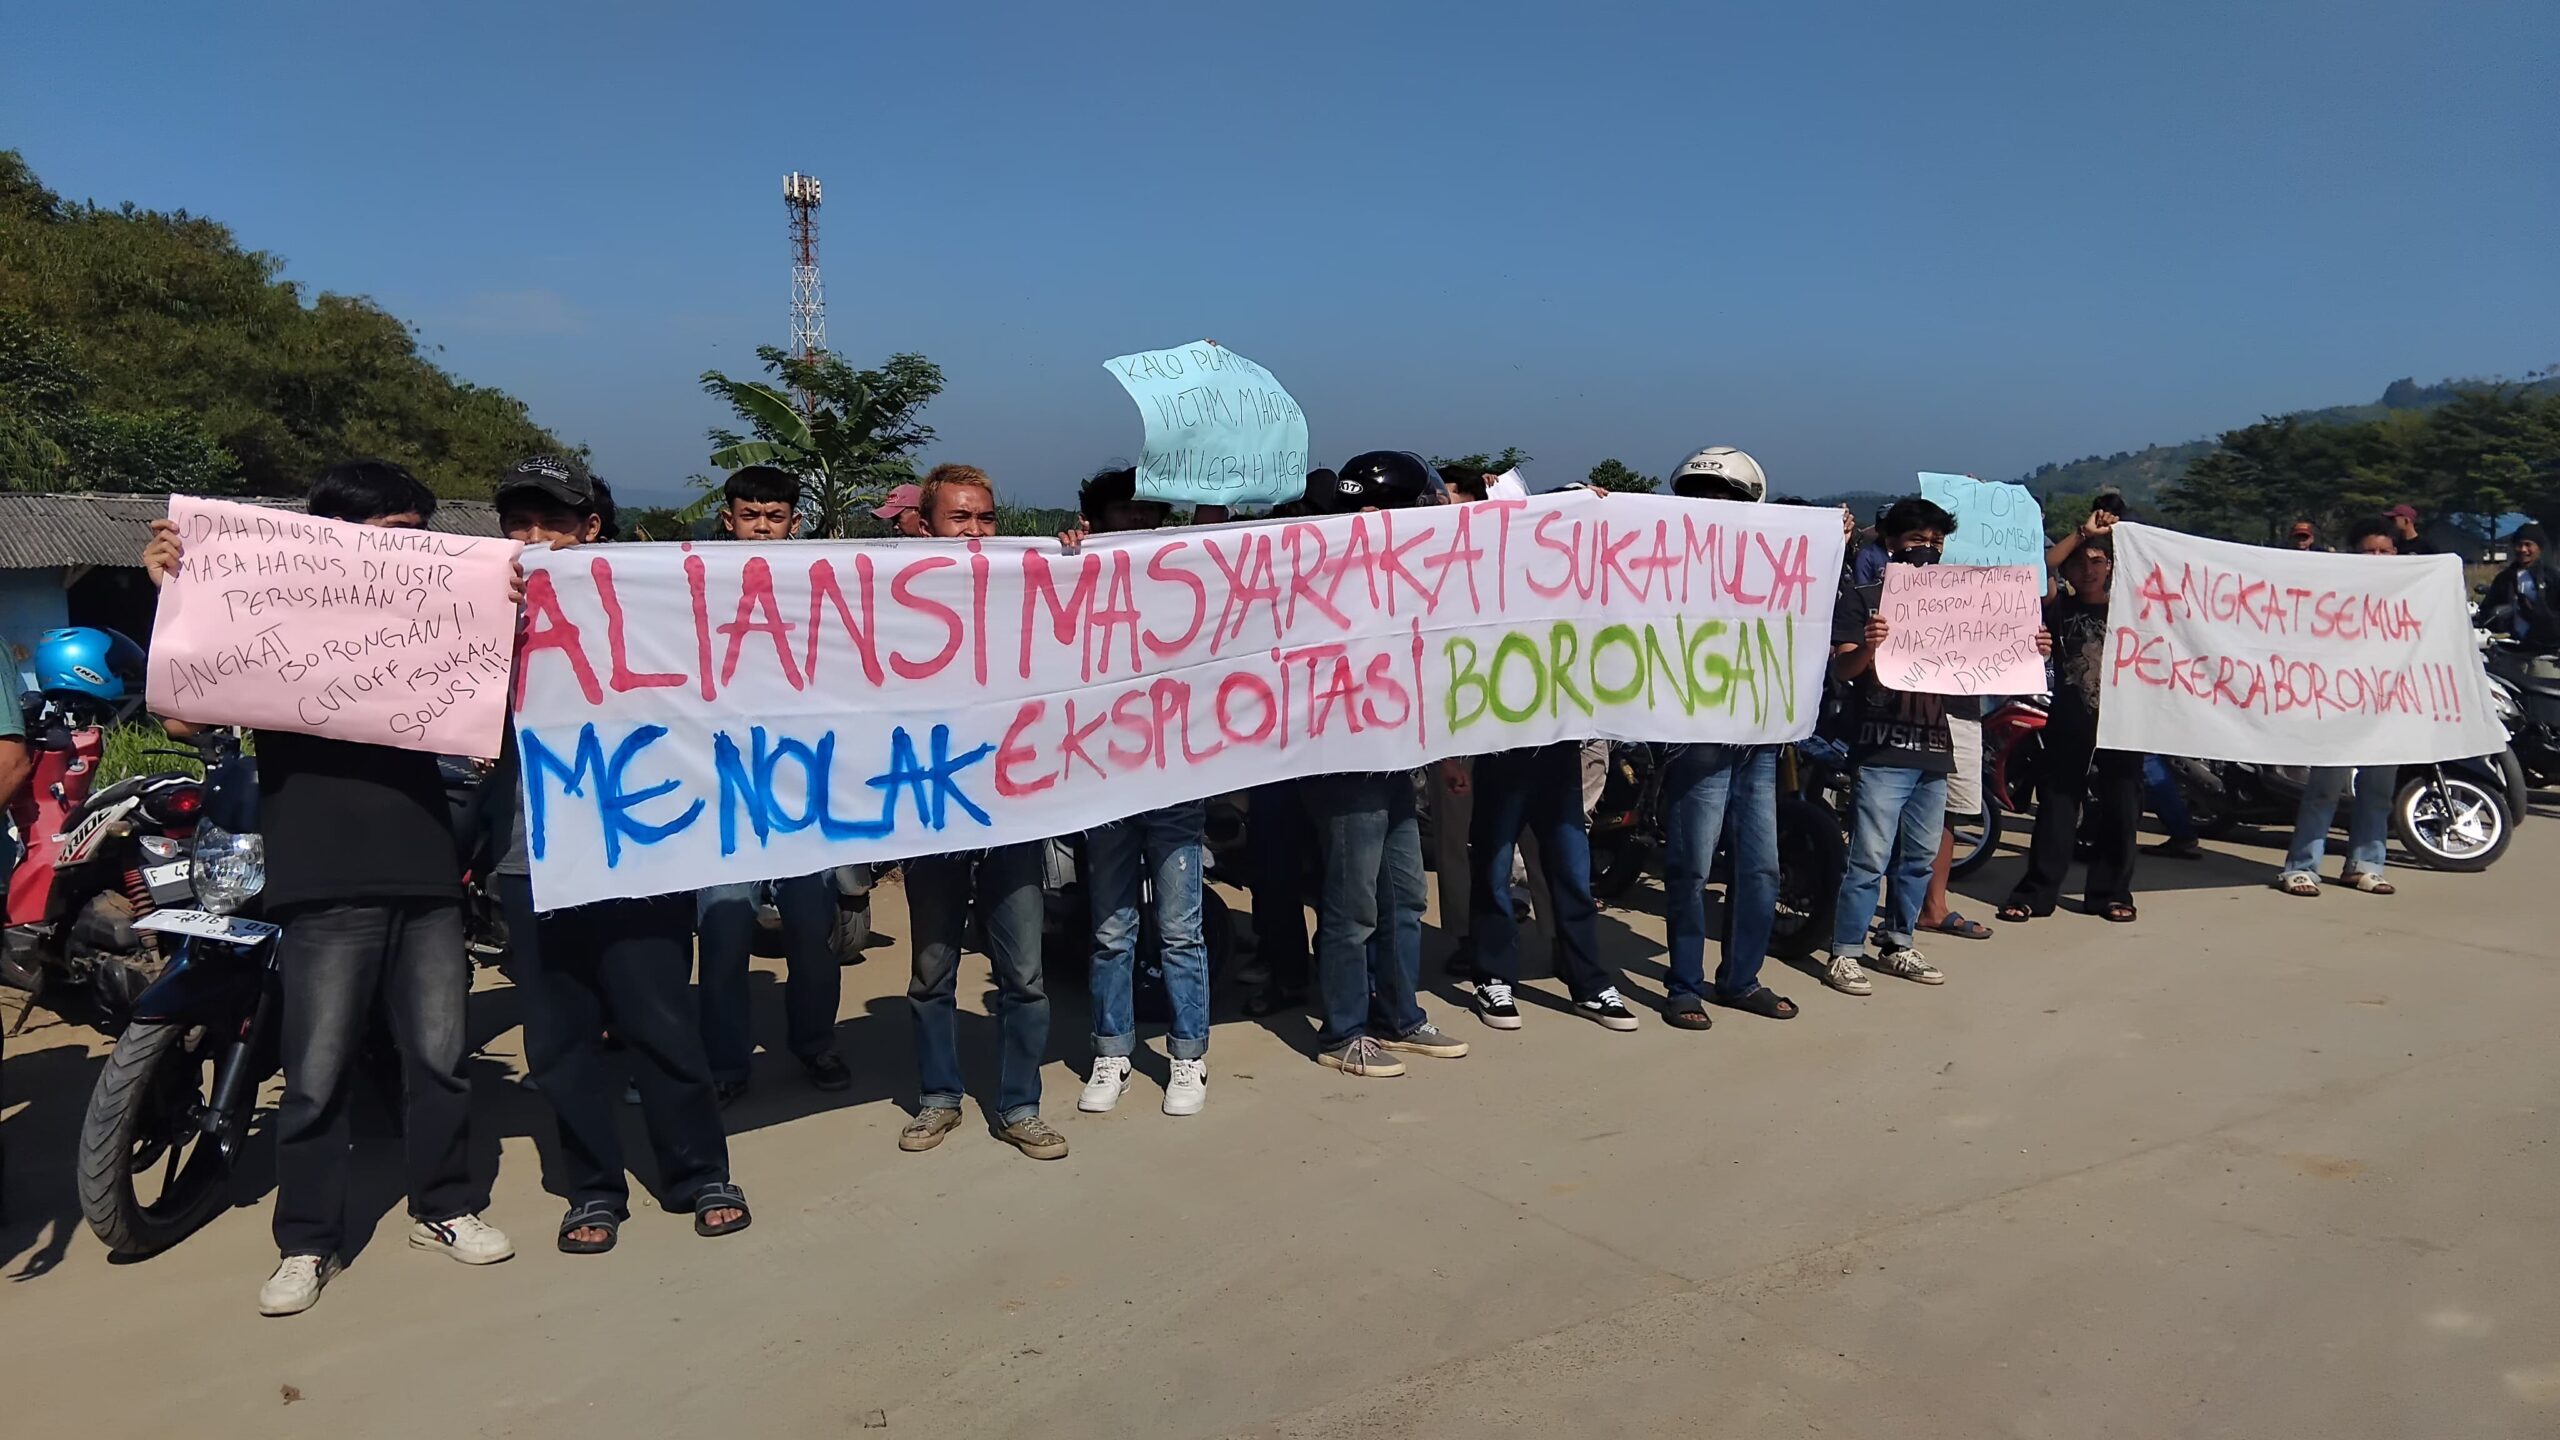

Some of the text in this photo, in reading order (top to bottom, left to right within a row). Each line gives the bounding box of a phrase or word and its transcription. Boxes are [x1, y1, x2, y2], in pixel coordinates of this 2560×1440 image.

[1117, 354, 1184, 383] KALO
[1140, 448, 1306, 496] KAMI LEBIH JAGO
[1942, 479, 2026, 520] STOP
[357, 531, 480, 557] MANTAN
[1981, 522, 2037, 552] DOMBA
[256, 550, 347, 578] HARUS
[1888, 570, 1938, 595] CUKUP
[1940, 569, 1977, 589] CHAT
[2016, 570, 2032, 586] GA
[514, 499, 1817, 713] ALIANSI MASYARAKAT SUKAMULYA
[1891, 620, 2024, 656] MASYARAKAT
[75, 667, 100, 682] INK
[168, 623, 291, 710] ANGKAT
[406, 636, 497, 692] BUKAN
[1900, 650, 1967, 689] WAJIB
[994, 616, 1426, 797] EKSPLOITASI
[1444, 612, 1796, 736] BORONGAN
[149, 870, 158, 883] F
